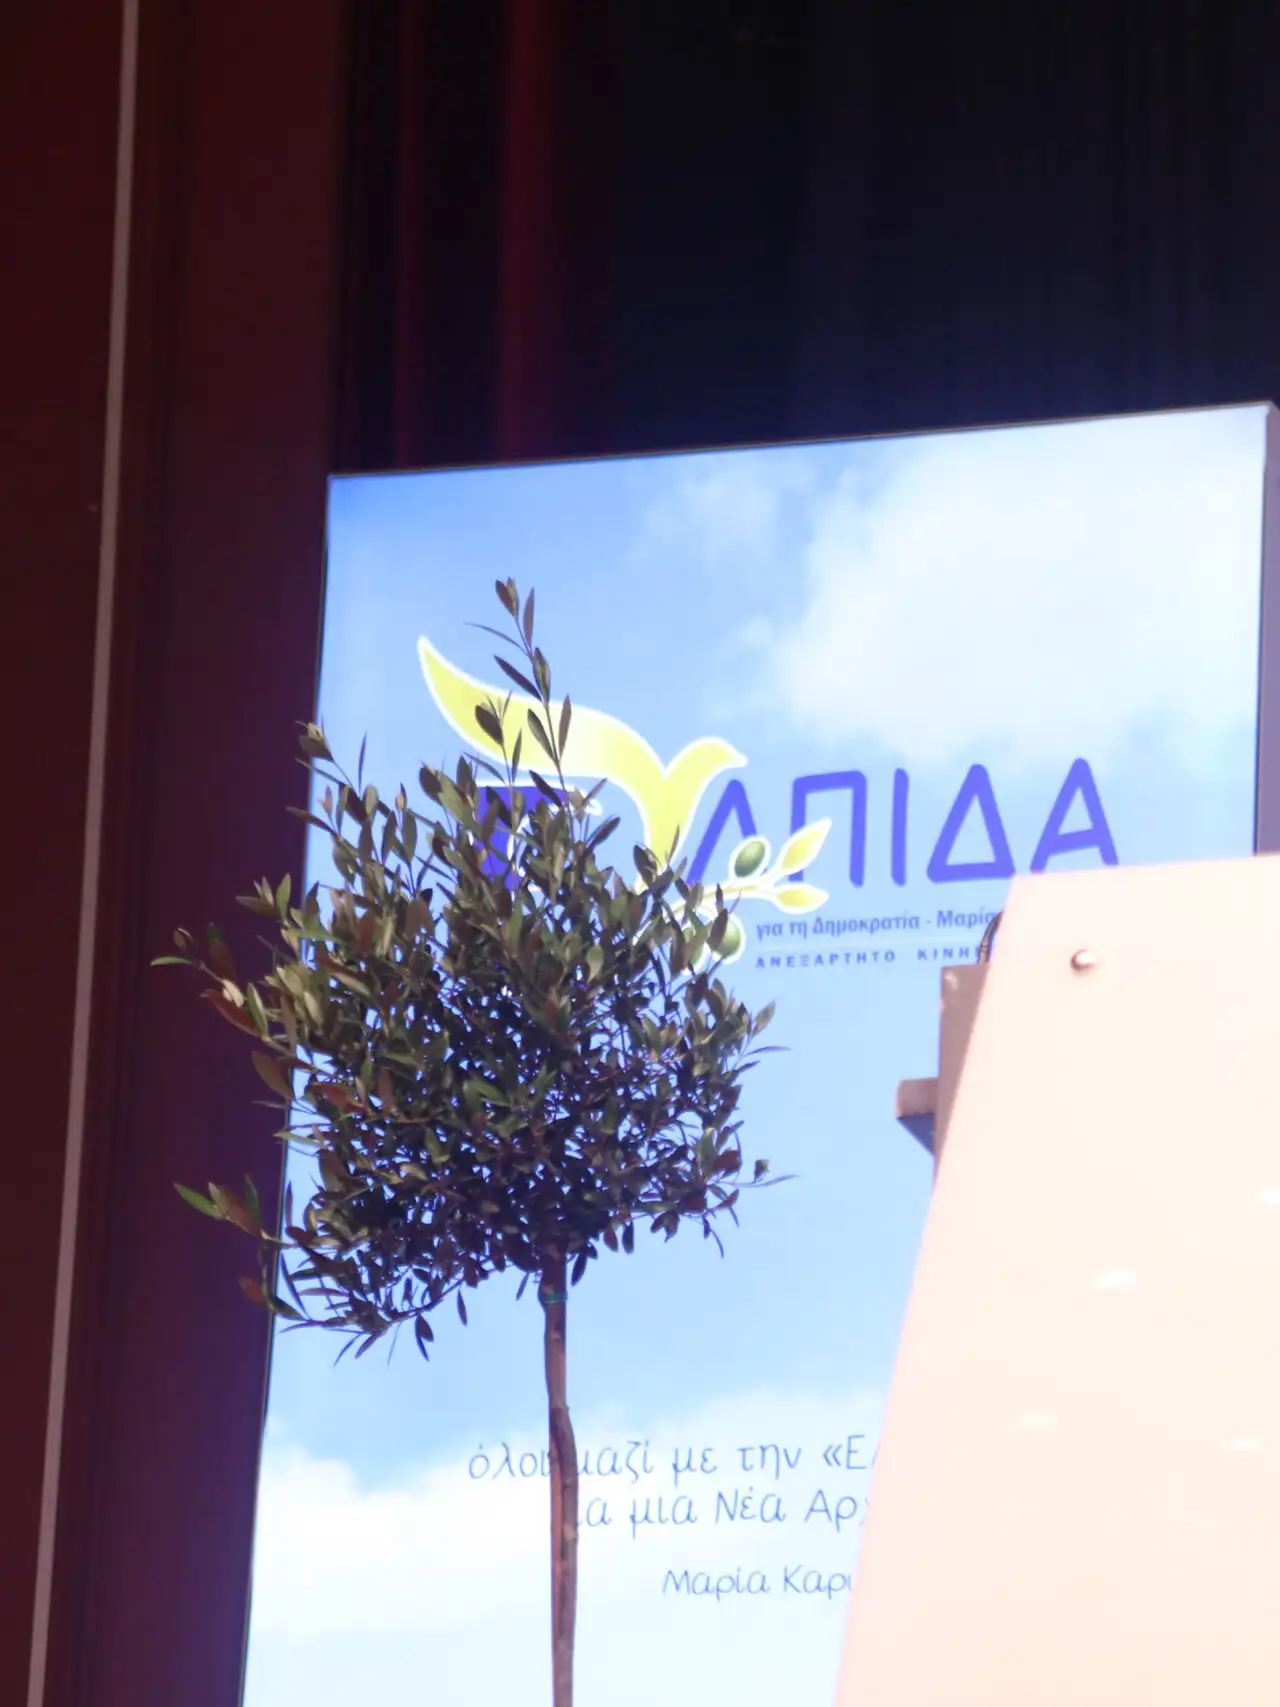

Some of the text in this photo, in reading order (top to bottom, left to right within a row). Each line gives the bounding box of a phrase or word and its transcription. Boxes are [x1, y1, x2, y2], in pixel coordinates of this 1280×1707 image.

[756, 922, 783, 941] για
[789, 919, 807, 939] τη
[813, 913, 920, 938] Δημοκρατία
[756, 945, 980, 969] ΑΝΕΞΑΡΤΗΤΟ ΚΙΝΗ
[671, 1447, 717, 1486] με
[738, 1444, 802, 1479] την
[630, 1495, 698, 1539] μια
[714, 1486, 787, 1525] Νέα
[661, 1566, 771, 1601] Μαρία
